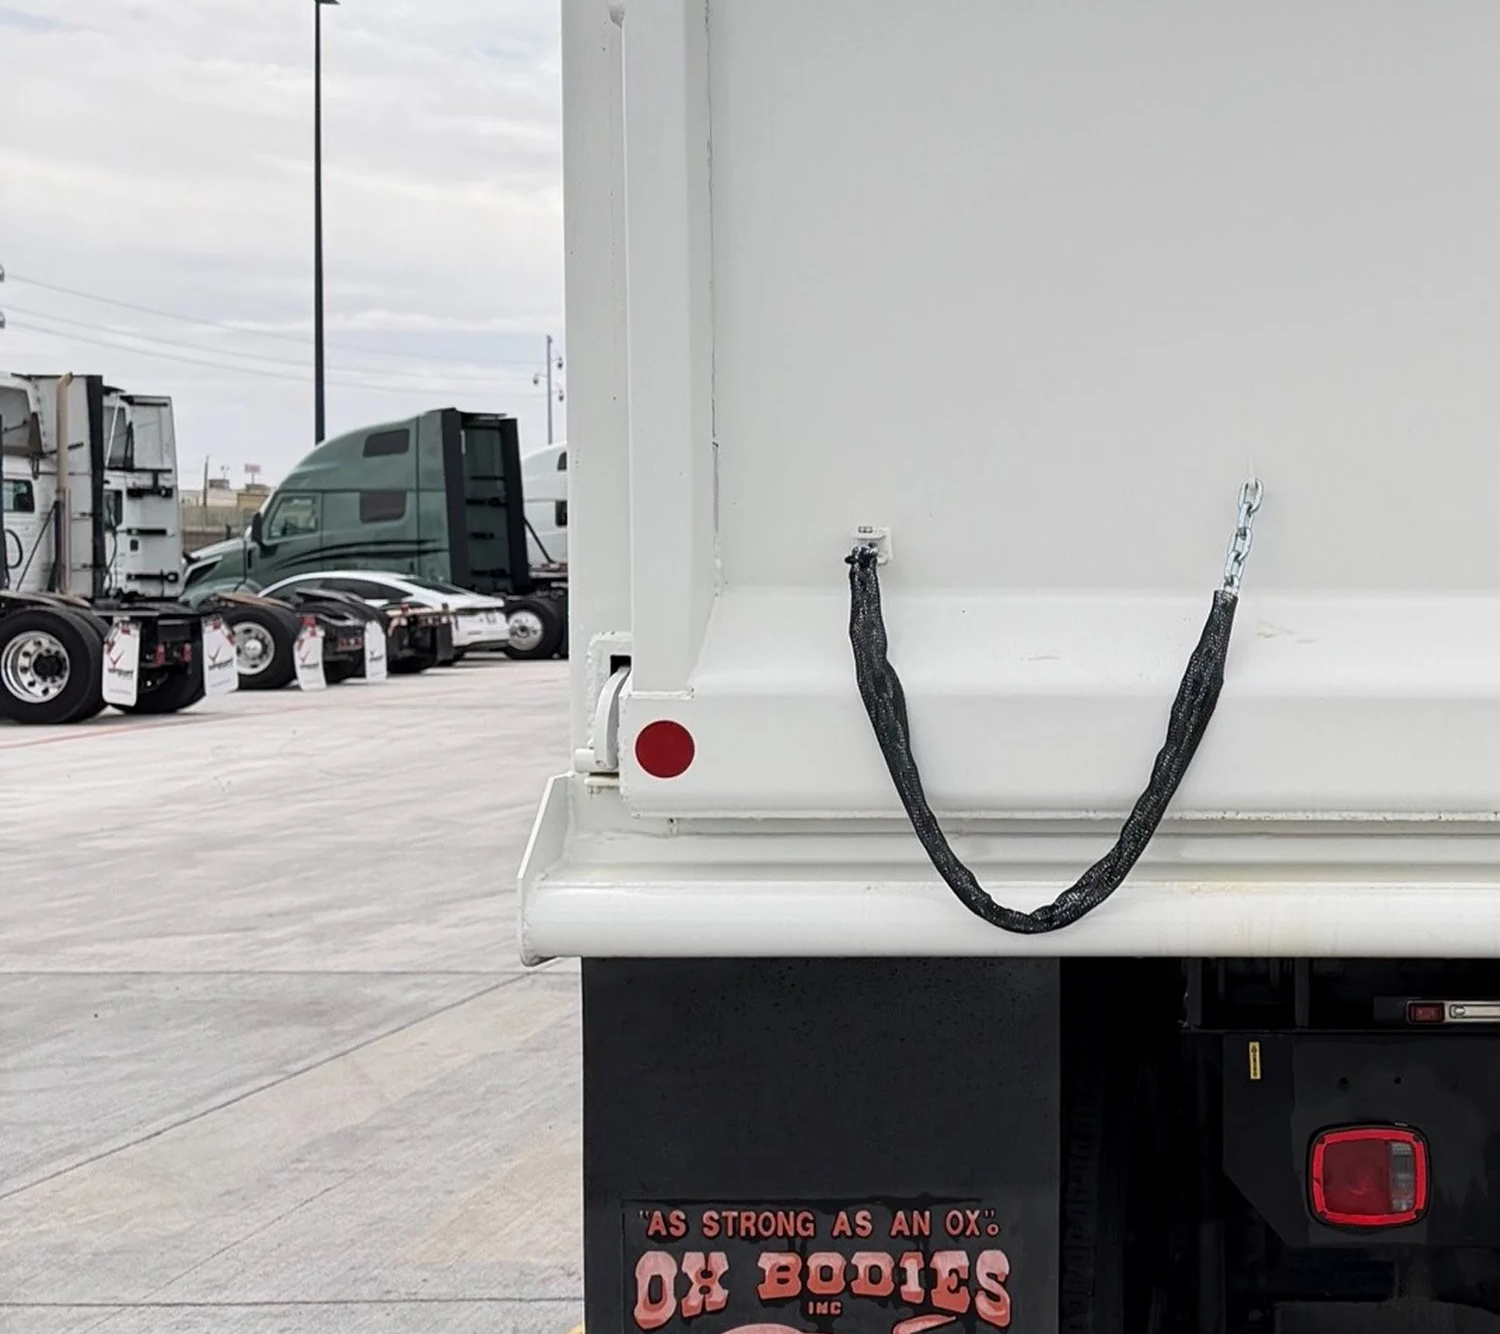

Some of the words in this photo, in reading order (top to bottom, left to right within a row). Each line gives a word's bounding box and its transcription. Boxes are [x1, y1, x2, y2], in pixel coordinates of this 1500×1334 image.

[702, 1210, 815, 1237] STRONG
[832, 1210, 872, 1237] AS
[890, 1210, 931, 1237] AN
[633, 1250, 729, 1330] OX
[757, 1249, 1011, 1327] BODIES
[808, 1301, 841, 1315] INC
